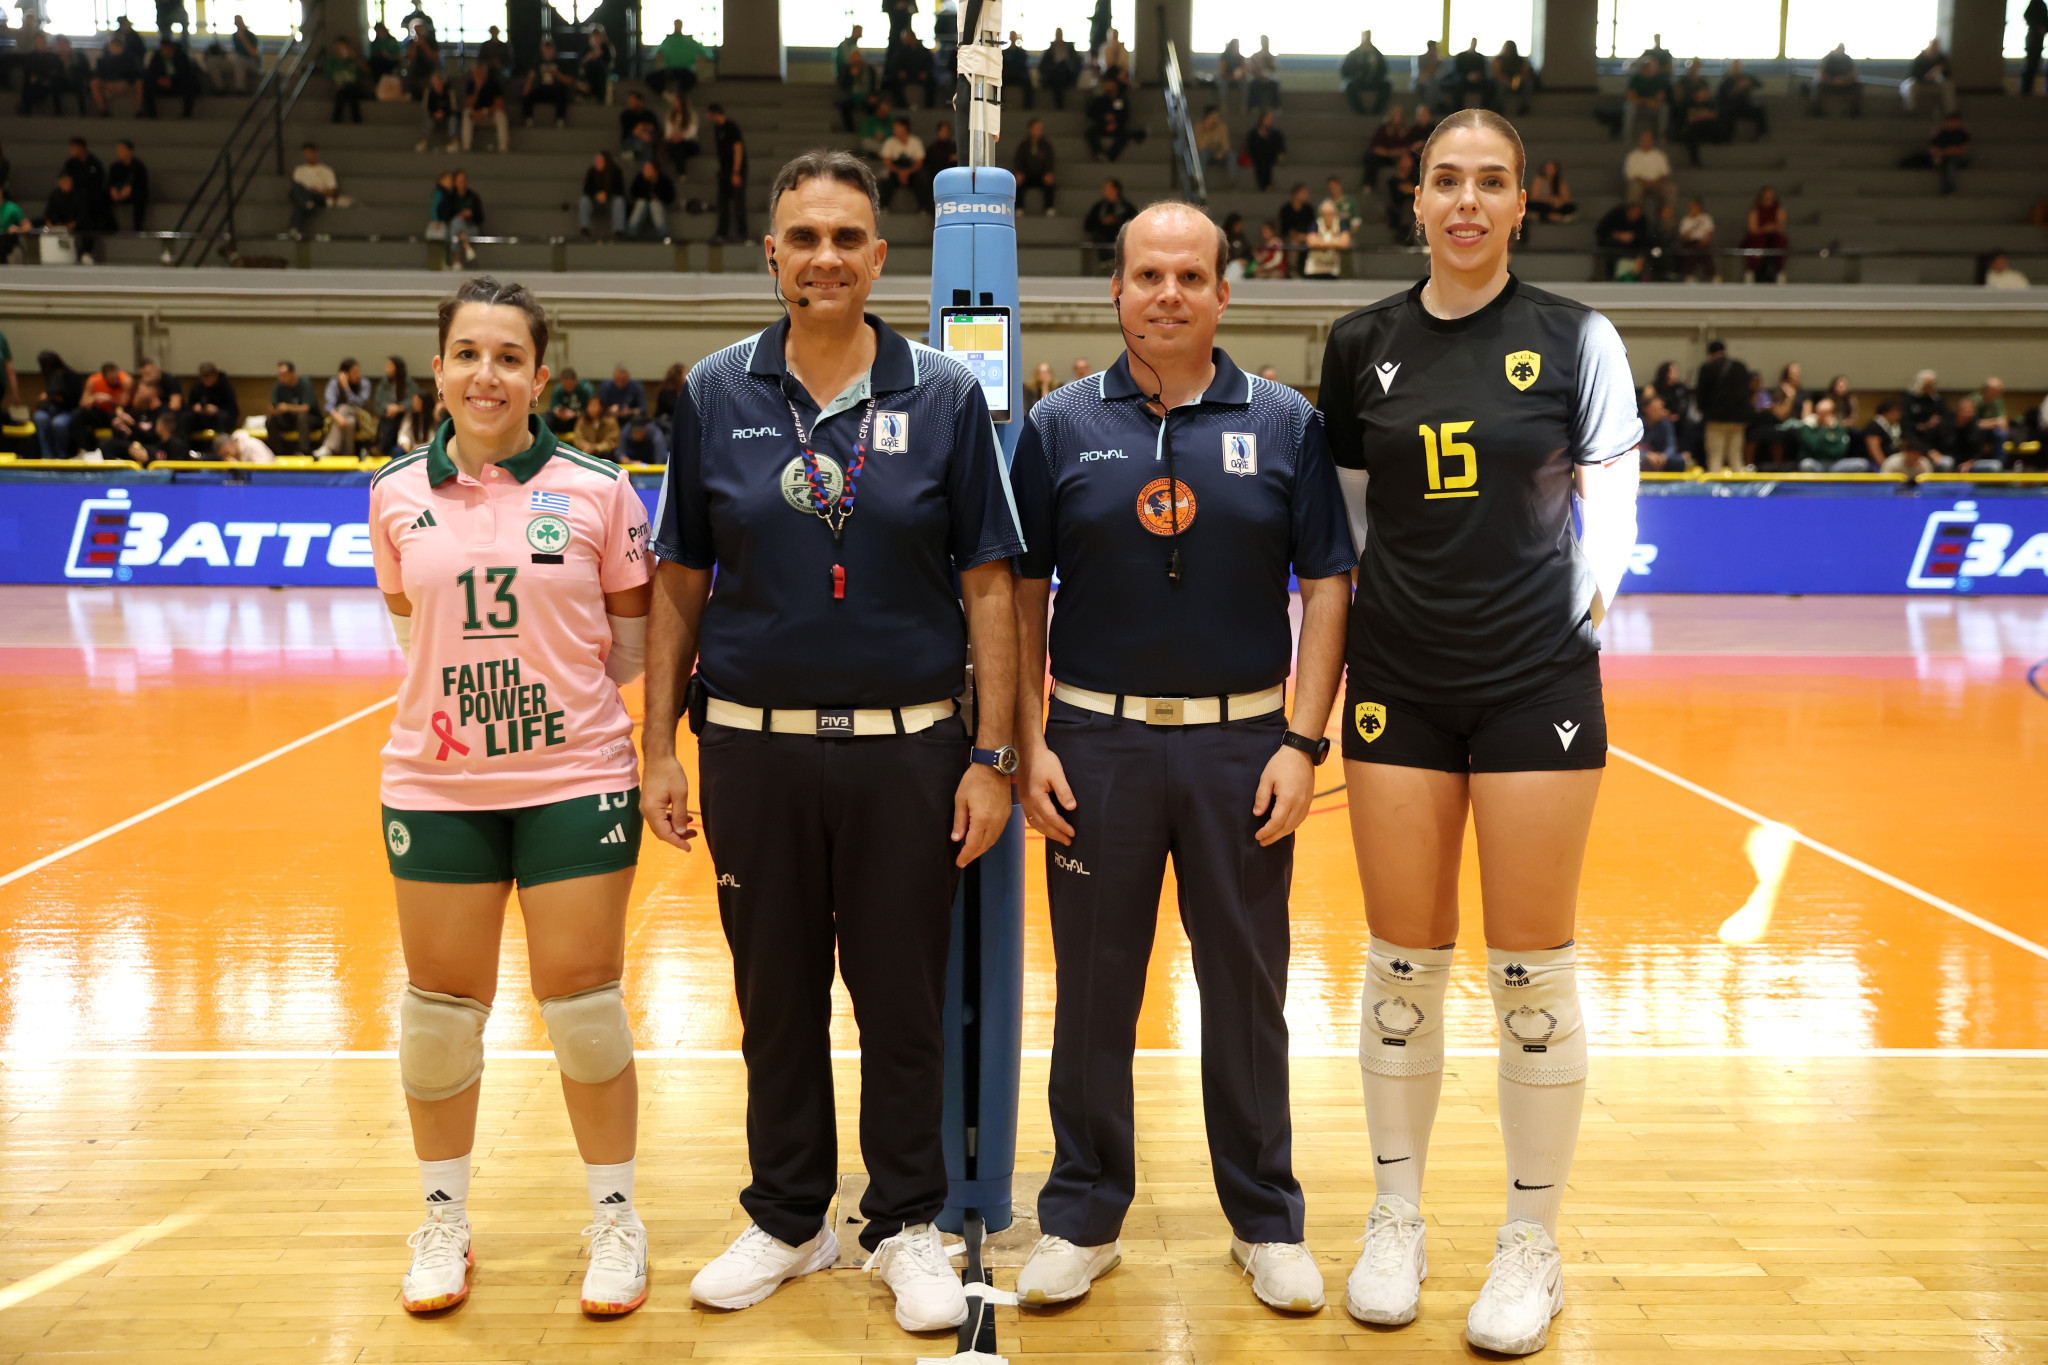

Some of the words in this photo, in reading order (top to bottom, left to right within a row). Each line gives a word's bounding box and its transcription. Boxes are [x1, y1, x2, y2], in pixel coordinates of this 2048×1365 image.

[863, 407, 874, 424] Enel
[732, 426, 782, 439] ROYAL
[796, 428, 807, 444] CEV
[859, 424, 869, 439] CEV
[1079, 449, 1128, 463] ROYAL
[1418, 420, 1479, 490] 15
[793, 469, 833, 484] FIB
[784, 489, 817, 511] INTERNATIONA
[118, 511, 374, 567] BATTE
[457, 565, 519, 632] 13
[442, 657, 521, 697] FAITH
[459, 682, 548, 727] POWER
[821, 716, 849, 727] FIVB
[485, 709, 566, 758] LIFE
[1055, 851, 1091, 875] ROYAL
